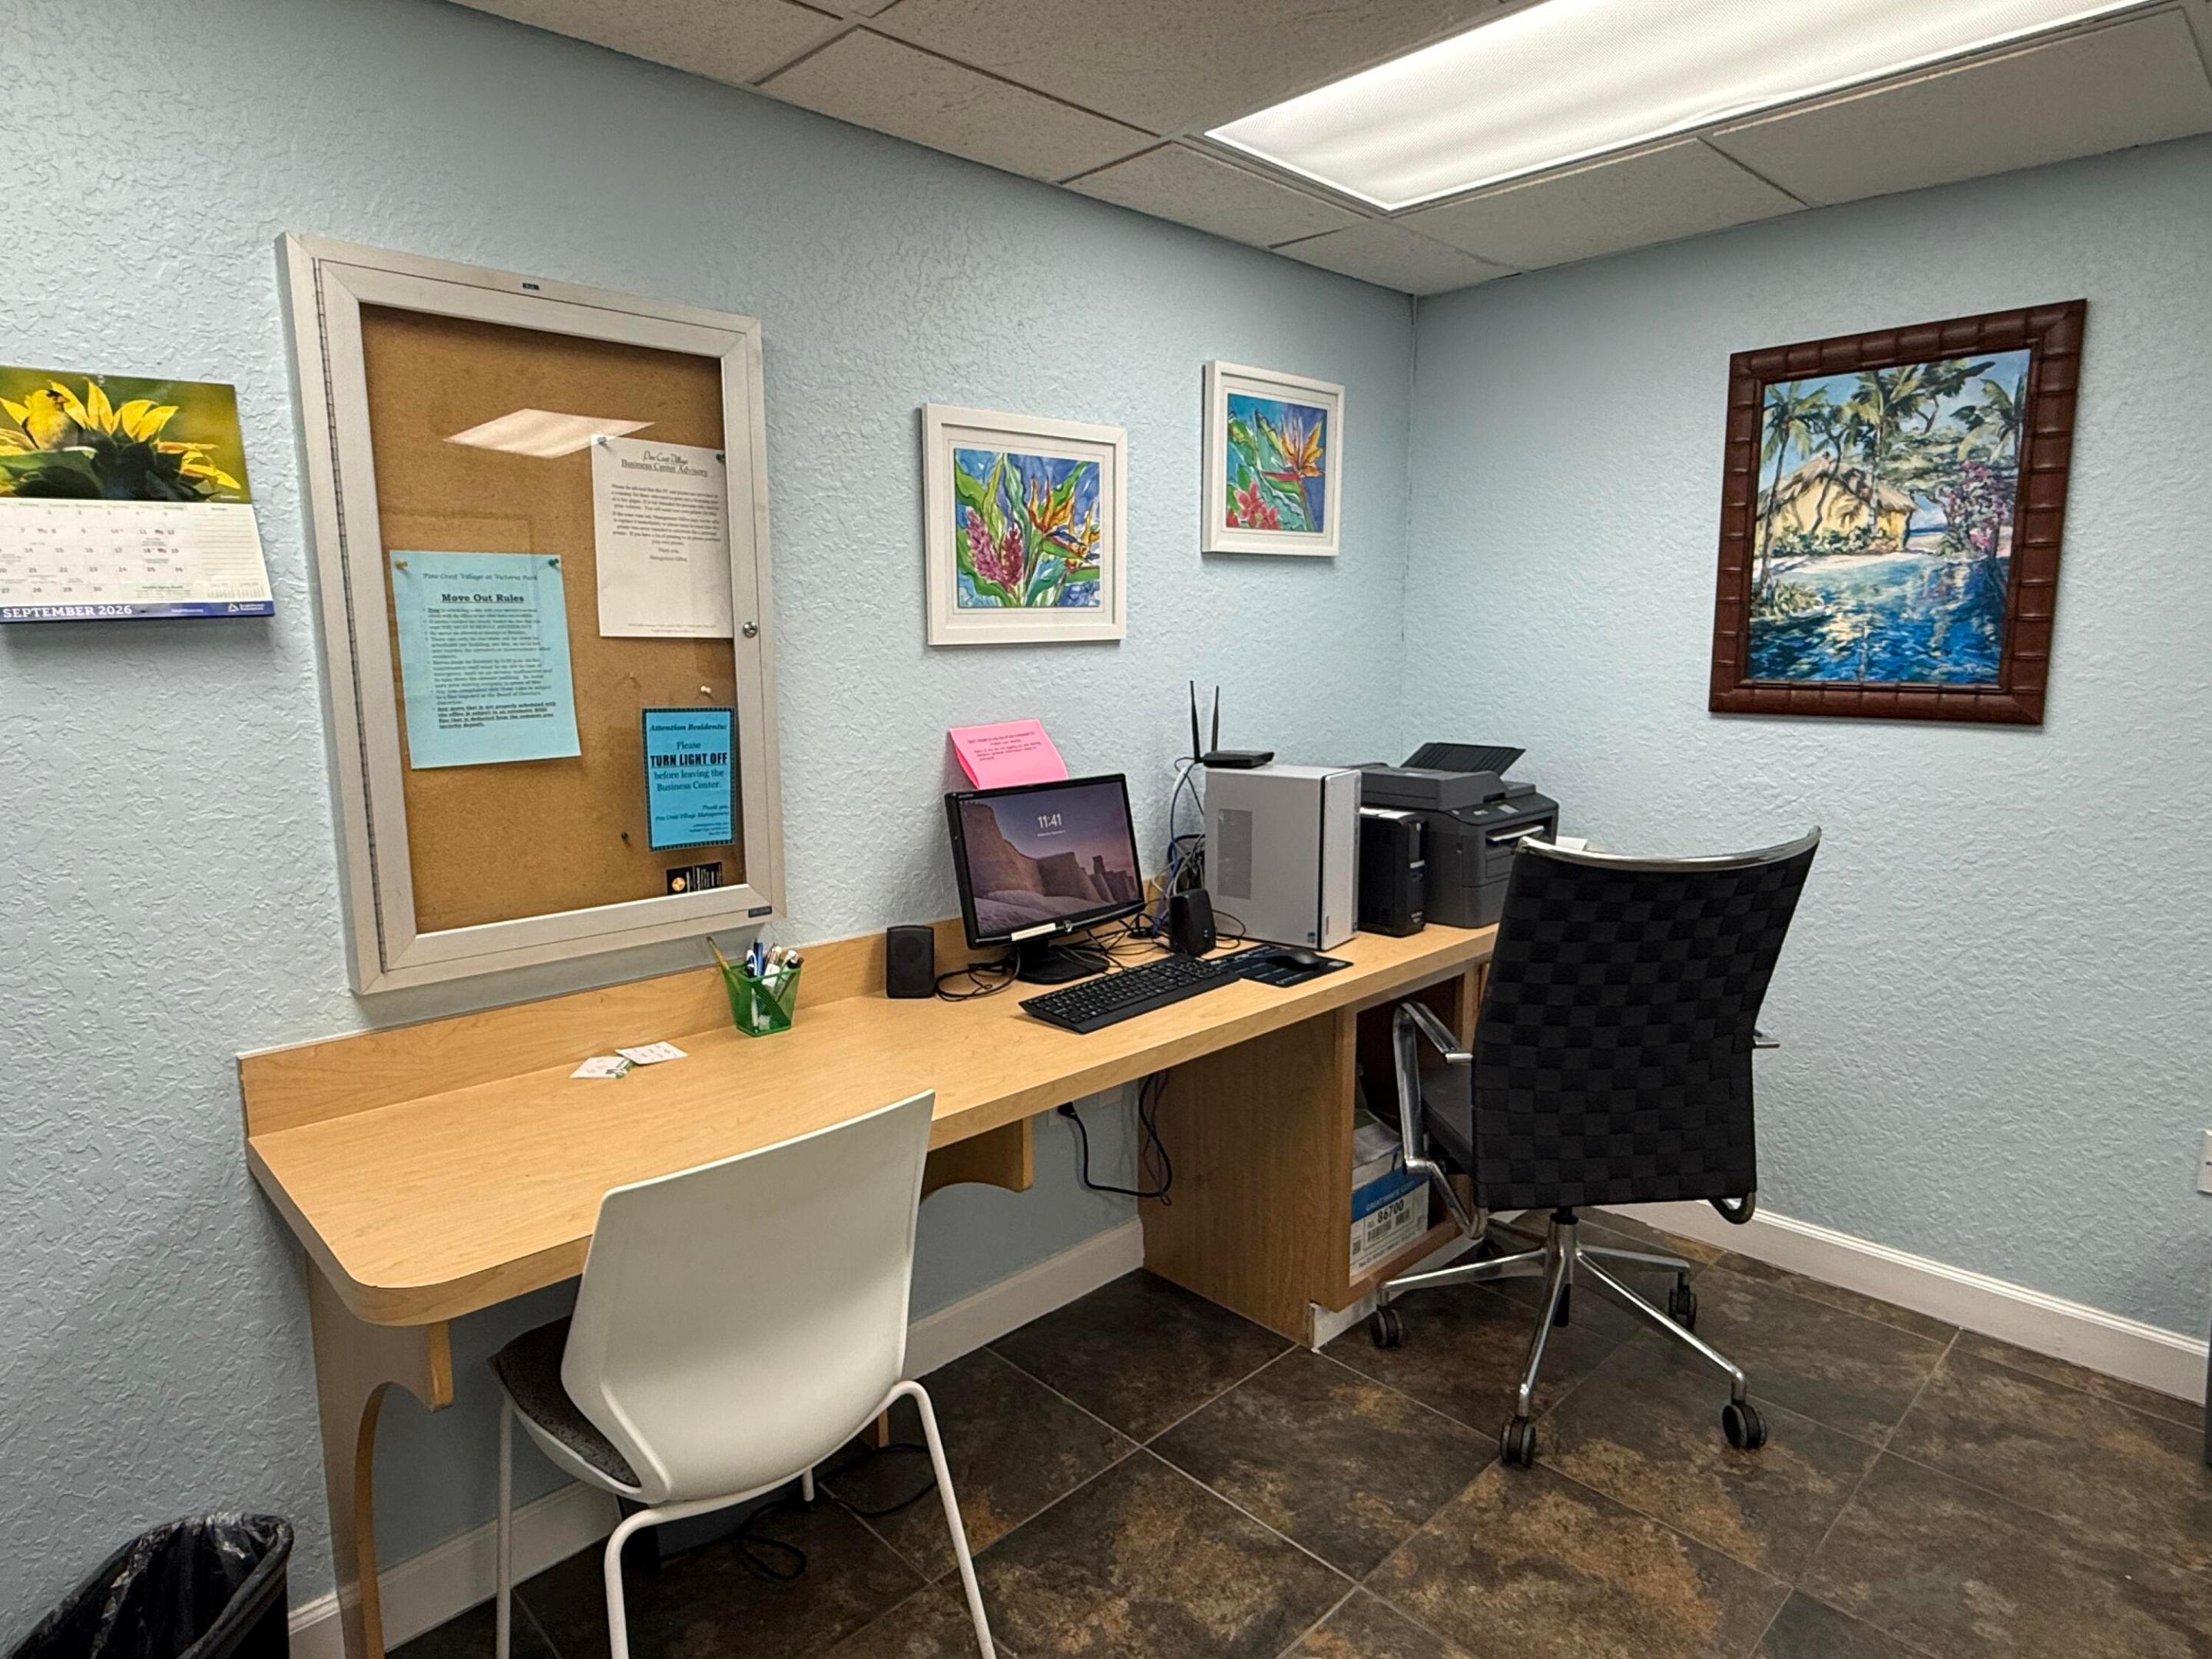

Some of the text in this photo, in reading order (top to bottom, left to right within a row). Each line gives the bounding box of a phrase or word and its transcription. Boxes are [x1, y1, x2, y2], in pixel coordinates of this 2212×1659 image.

[442, 594, 525, 602] Move Out Rules
[3, 605, 132, 618] SEPTEMBER 2026
[677, 740, 701, 750] Please
[650, 752, 727, 767] TURN LIGHT OFF
[654, 768, 724, 780] before leaving the
[657, 783, 691, 792] Business
[1038, 813, 1061, 829] 11:41
[1377, 1199, 1404, 1224] 86700
